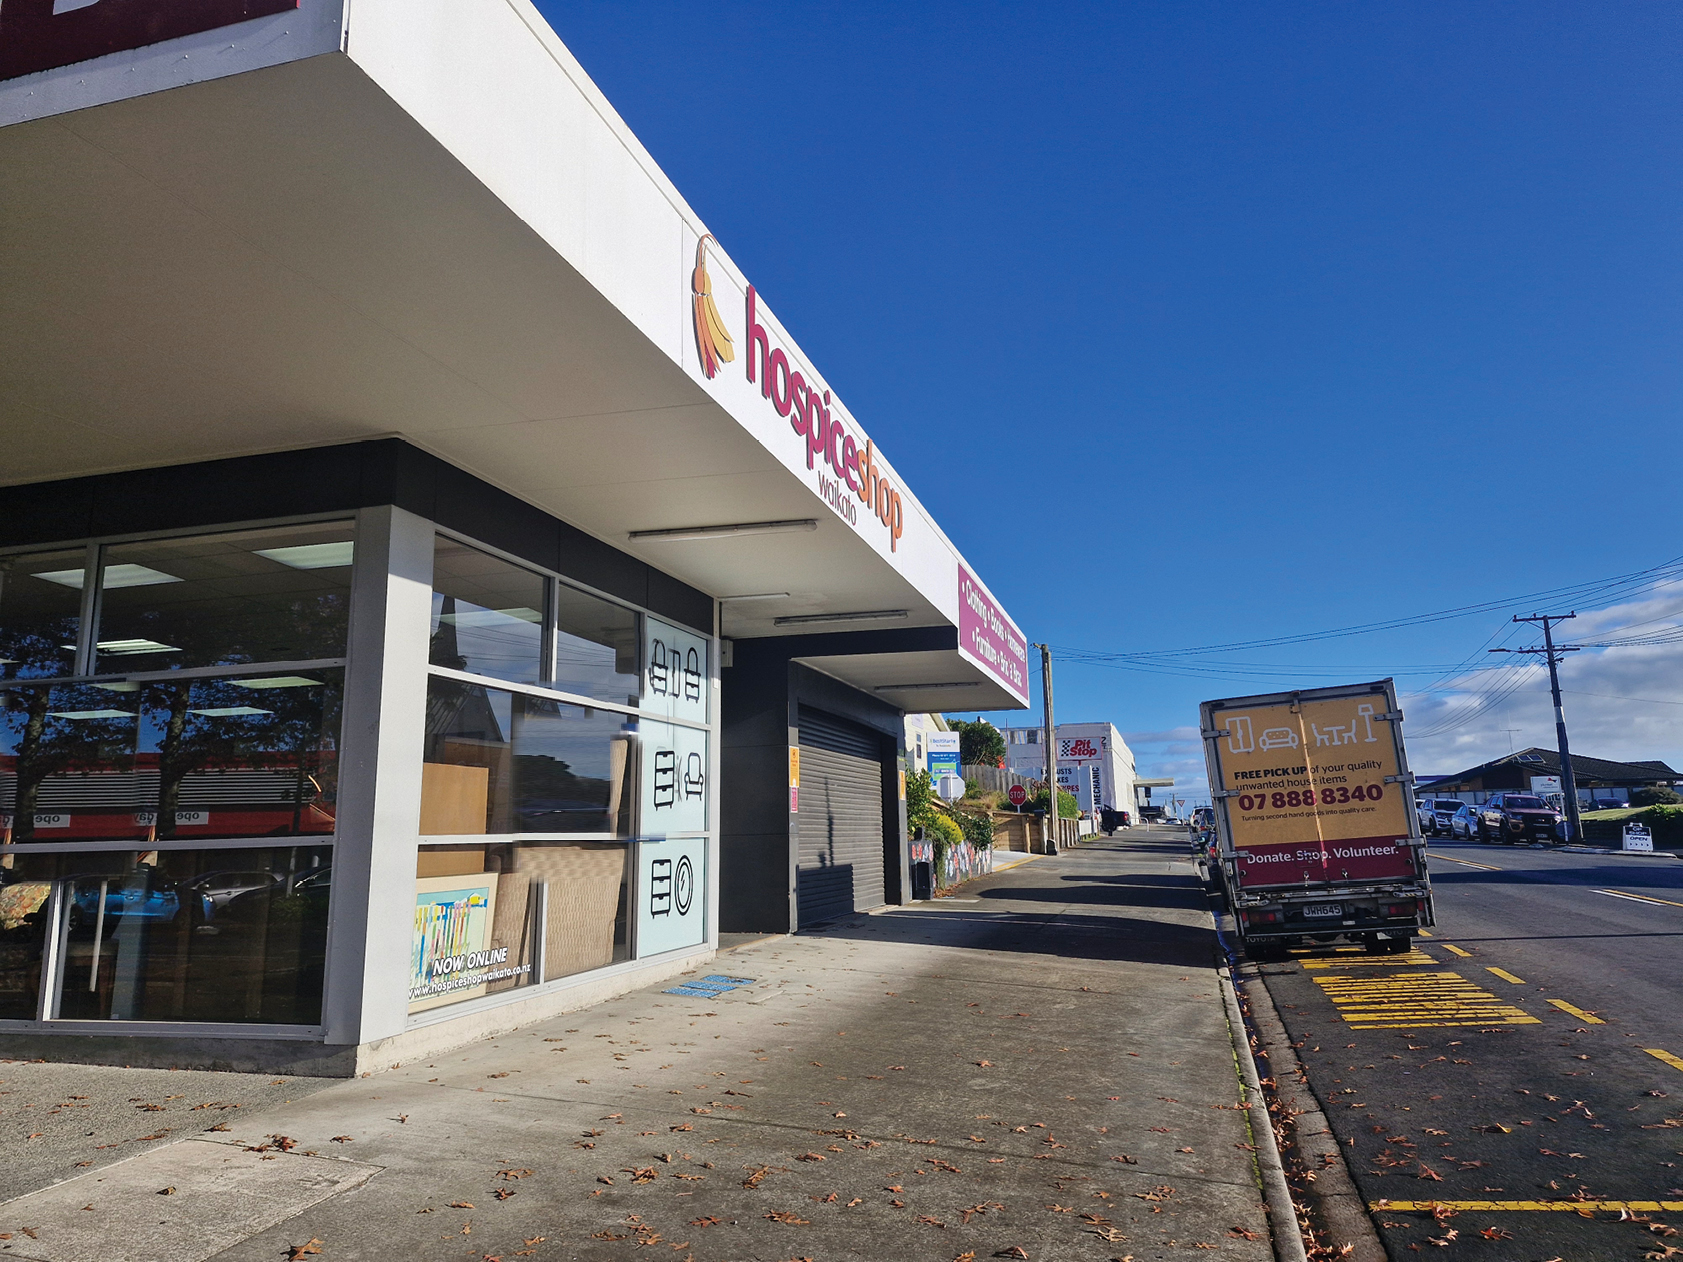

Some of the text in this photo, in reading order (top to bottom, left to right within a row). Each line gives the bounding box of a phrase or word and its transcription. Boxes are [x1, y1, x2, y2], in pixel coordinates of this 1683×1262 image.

[818, 470, 857, 526] waikato
[965, 579, 988, 629] Clothing
[1069, 748, 1097, 757] Stop
[1074, 739, 1092, 749] Pit
[1234, 760, 1382, 780] FREE PICK UP of your quality
[1092, 767, 1102, 805] MECHANIC
[1236, 775, 1347, 791] unwanted house items
[1009, 791, 1025, 799] STOP
[1238, 784, 1383, 811] 07 888 8340
[1266, 812, 1288, 820] second
[1339, 807, 1360, 815] quality
[1247, 845, 1399, 864] Donate. Shop. Volunteer.
[1304, 904, 1341, 916] JWH645
[432, 947, 508, 975] NOW ONLINE
